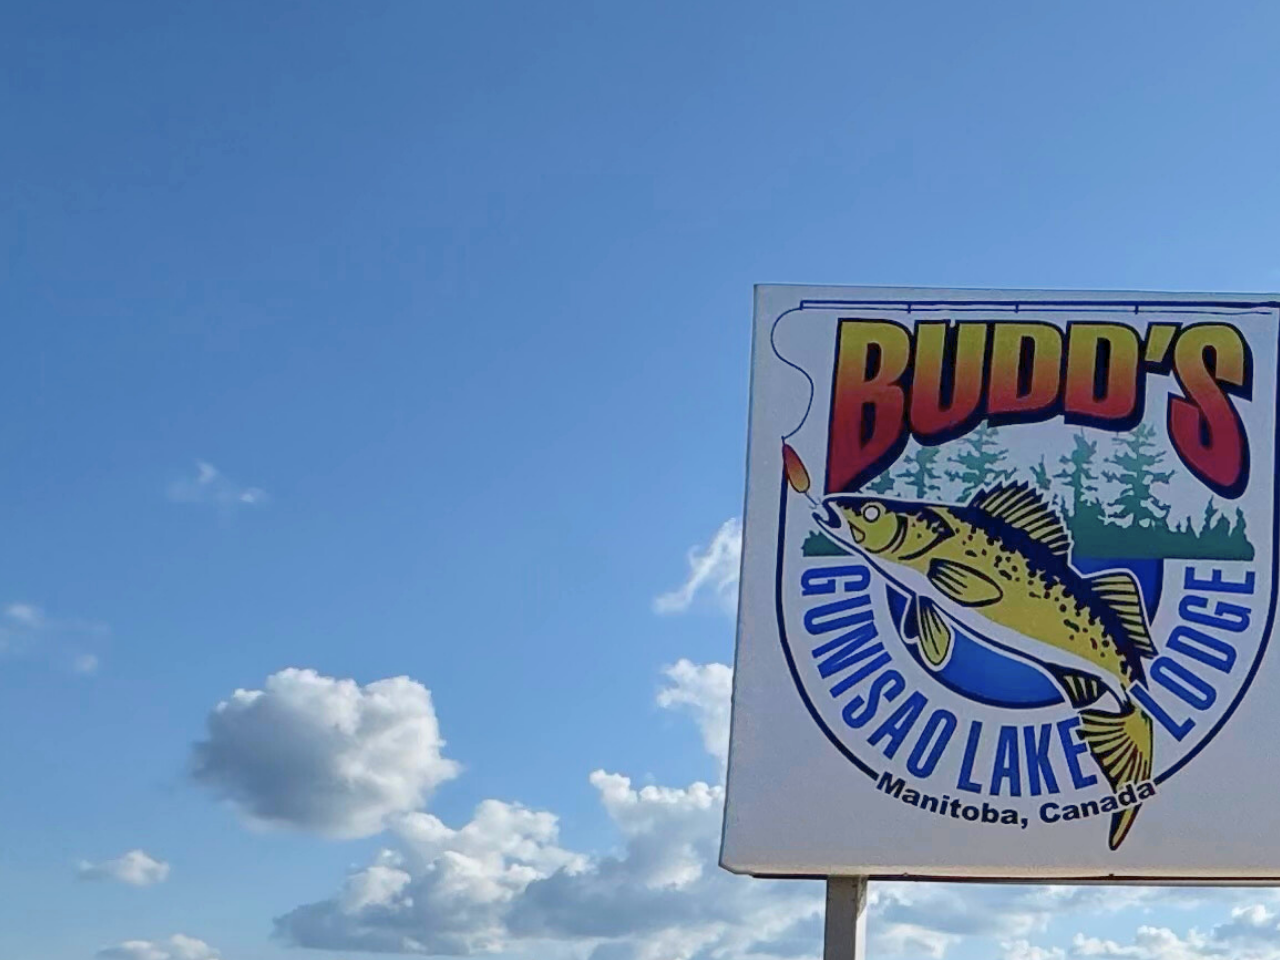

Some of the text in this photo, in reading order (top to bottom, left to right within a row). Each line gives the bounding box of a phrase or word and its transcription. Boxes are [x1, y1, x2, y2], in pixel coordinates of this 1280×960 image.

[823, 317, 1254, 500] BUDD'S
[800, 564, 1256, 798] GUNISAO LAKE LODGE
[876, 770, 1157, 830] Manitoba, Canada
